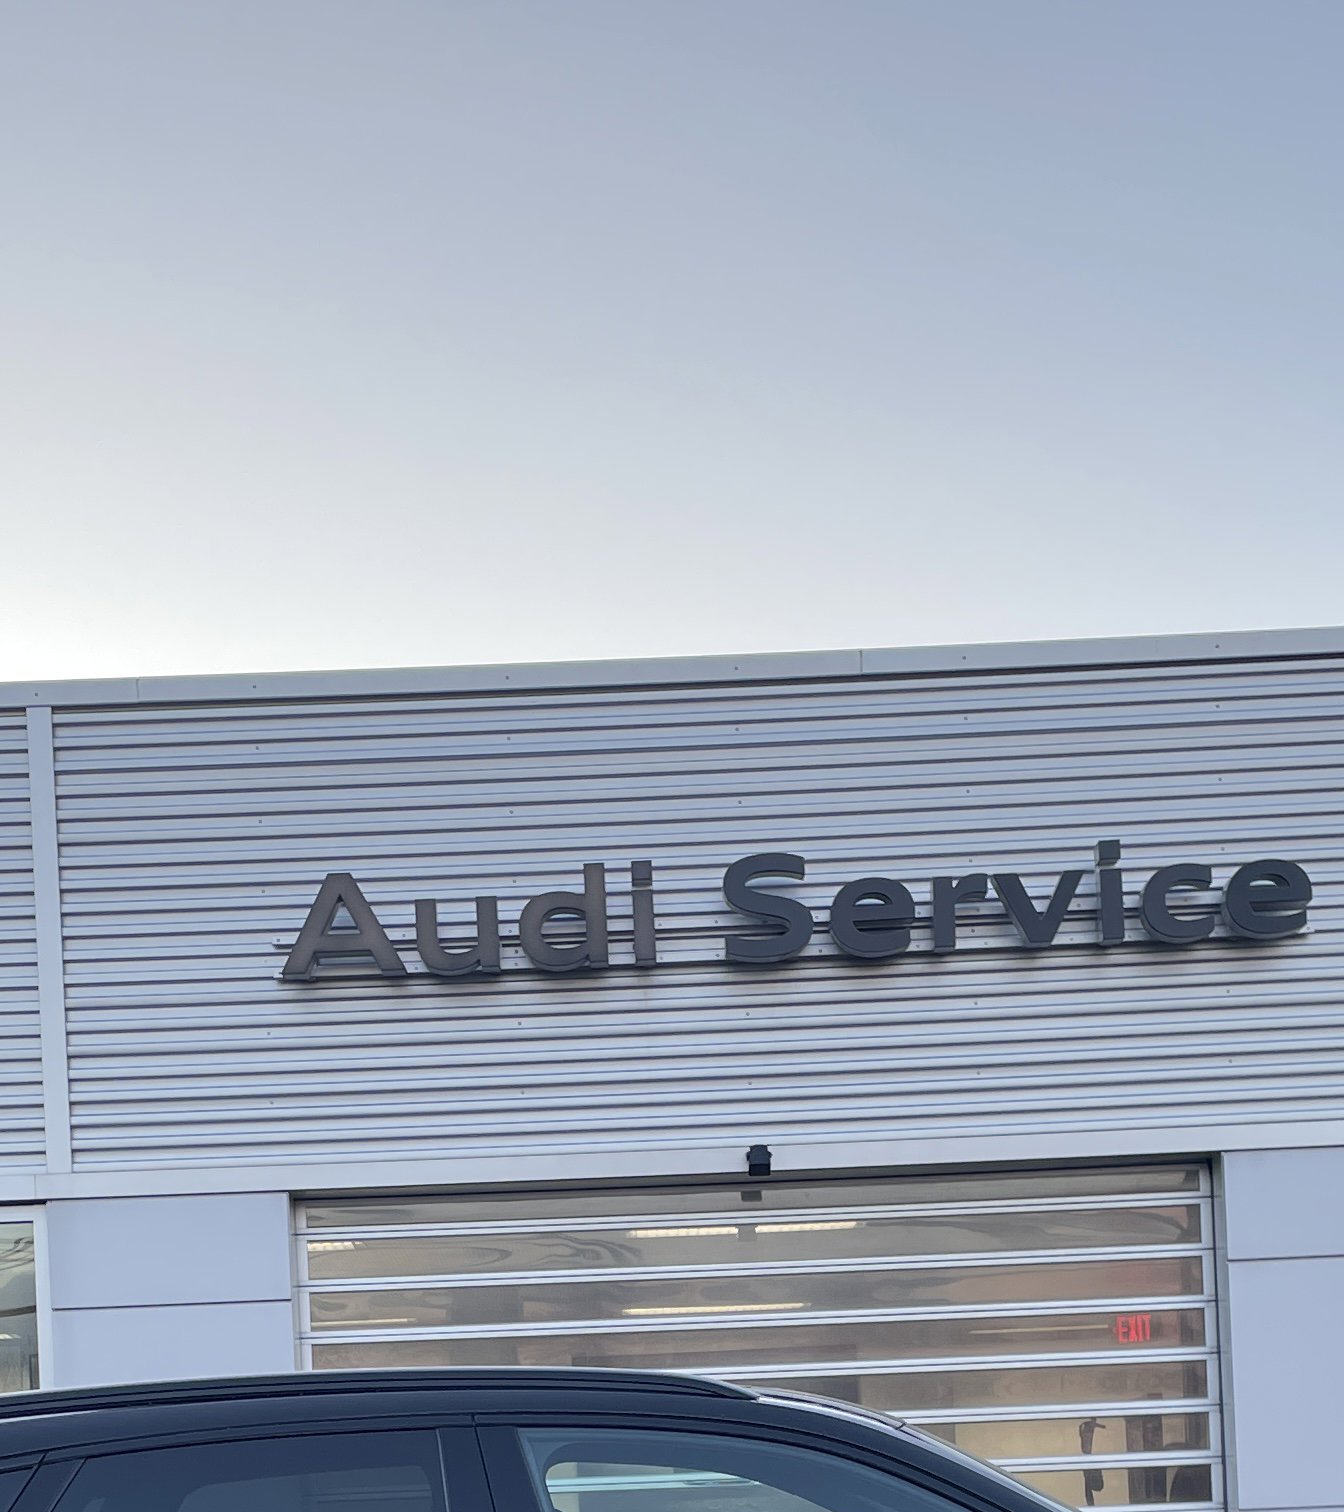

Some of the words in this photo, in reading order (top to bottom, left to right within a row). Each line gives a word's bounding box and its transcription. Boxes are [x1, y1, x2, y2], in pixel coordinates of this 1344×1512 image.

[282, 860, 657, 981] Audi
[723, 840, 1313, 963] Service
[1117, 1313, 1151, 1343] EXIT
